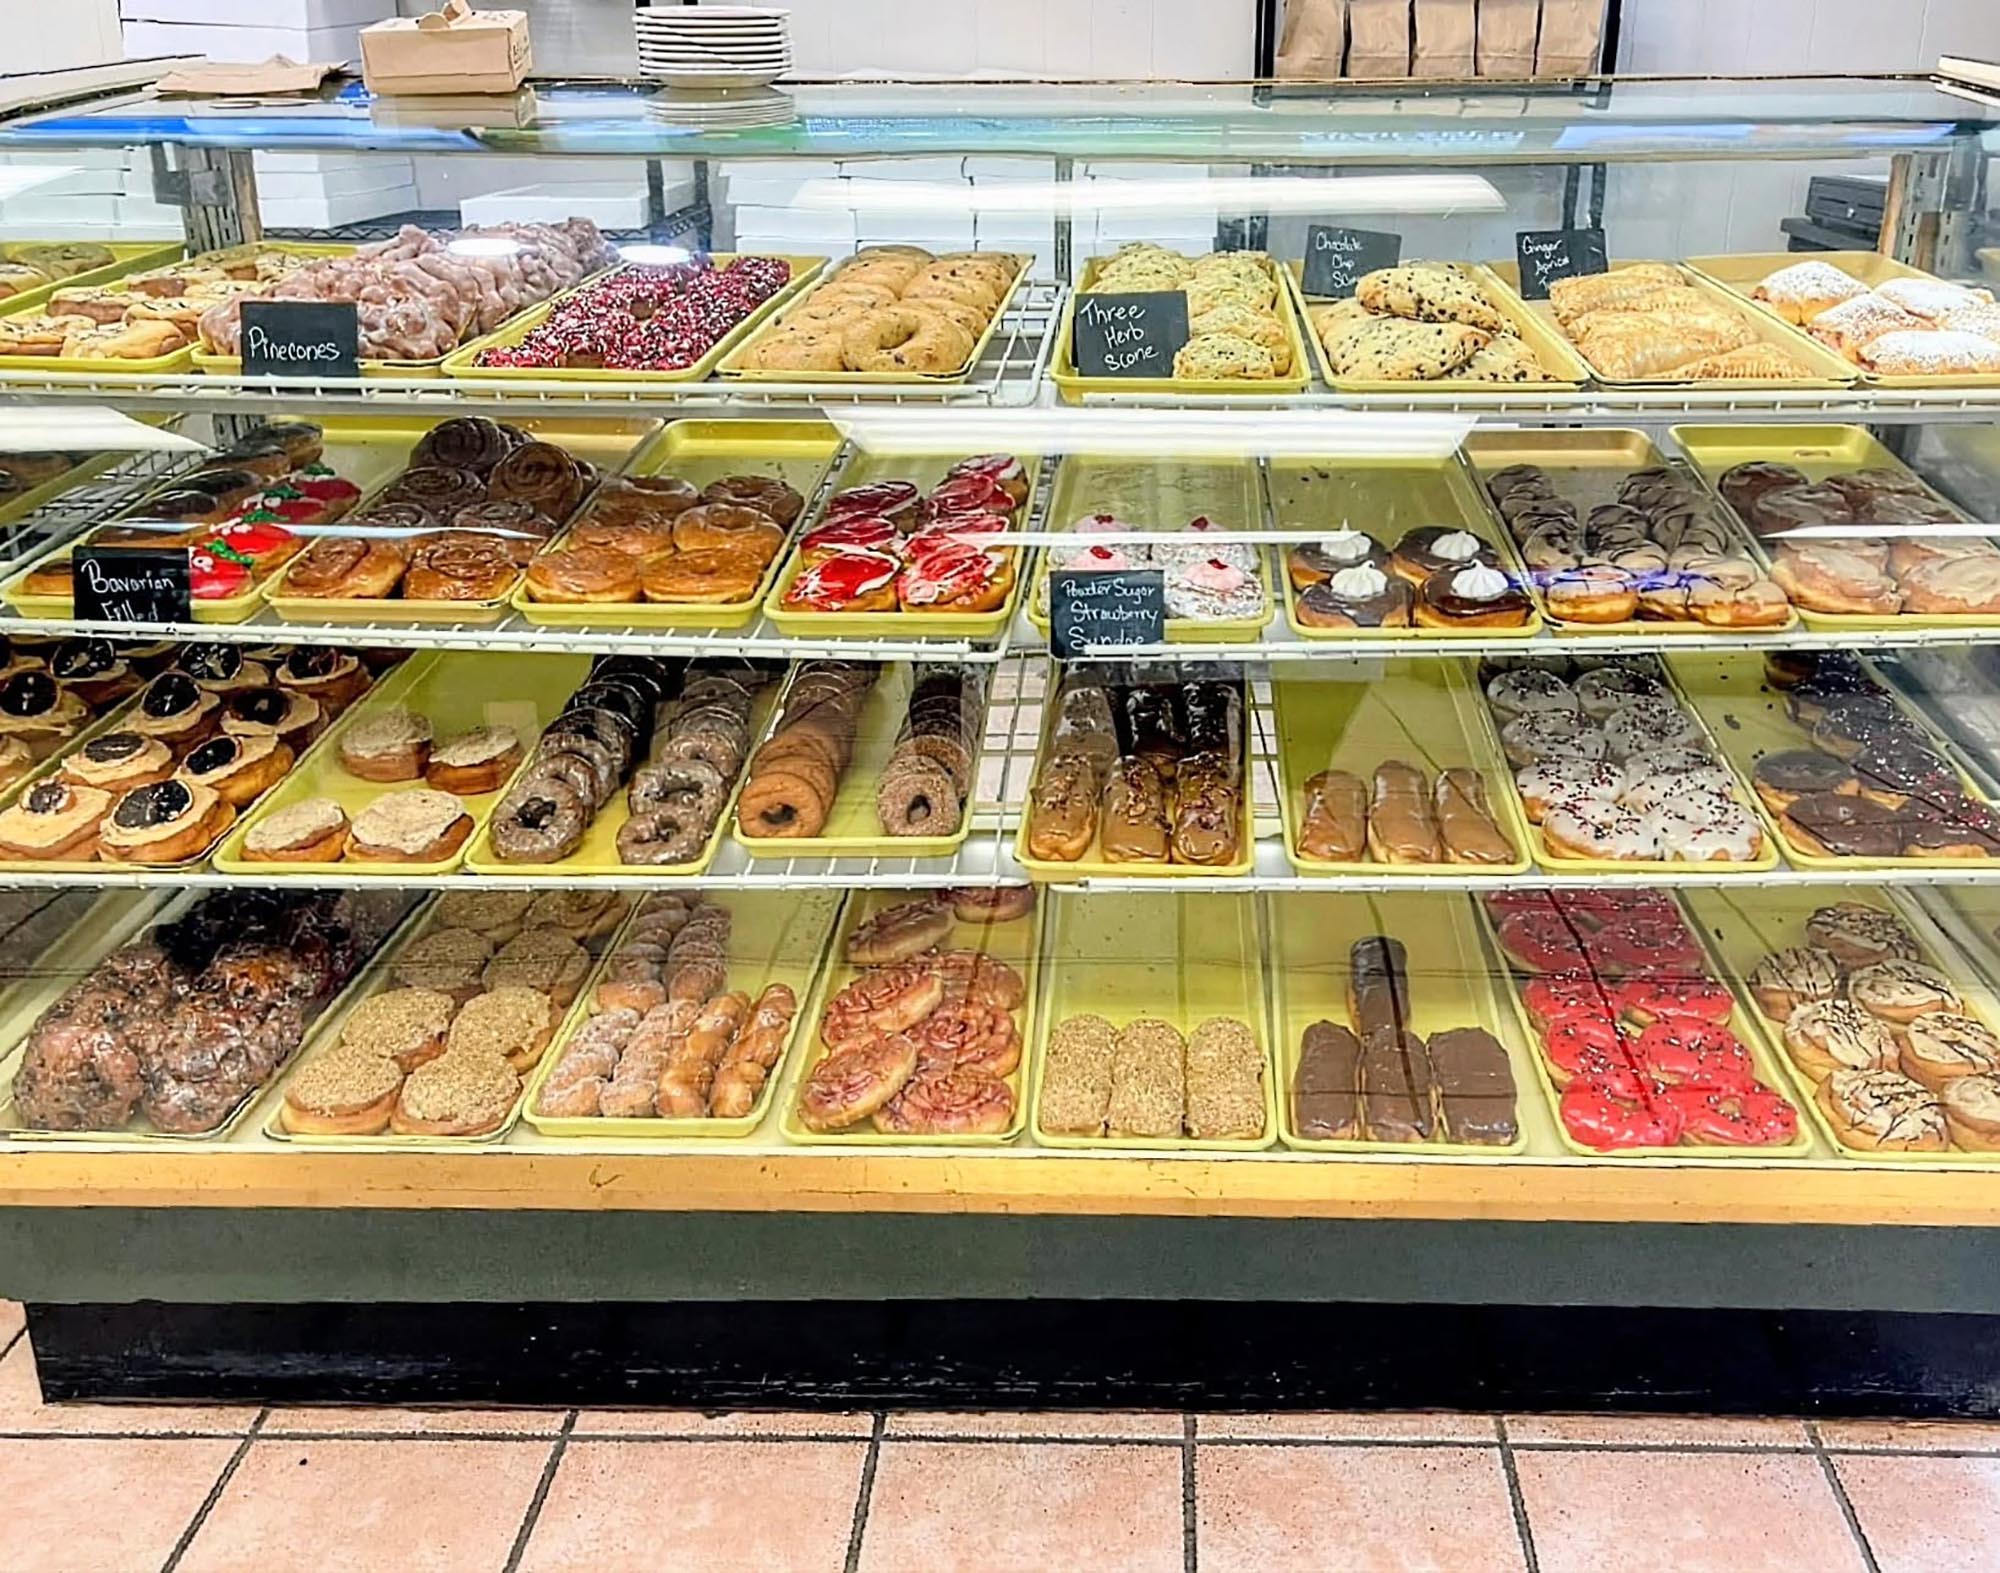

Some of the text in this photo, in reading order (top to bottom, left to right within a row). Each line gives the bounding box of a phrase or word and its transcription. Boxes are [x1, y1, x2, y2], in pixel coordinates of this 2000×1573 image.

[1522, 235, 1563, 259] Ginger
[1080, 297, 1146, 327] Three
[248, 325, 341, 361] Pinecones
[1104, 321, 1145, 349] Herb
[1104, 345, 1160, 371] Scone
[80, 558, 175, 593] Bavarian
[1112, 577, 1155, 605] Sugar
[1070, 600, 1158, 629] Strawberry
